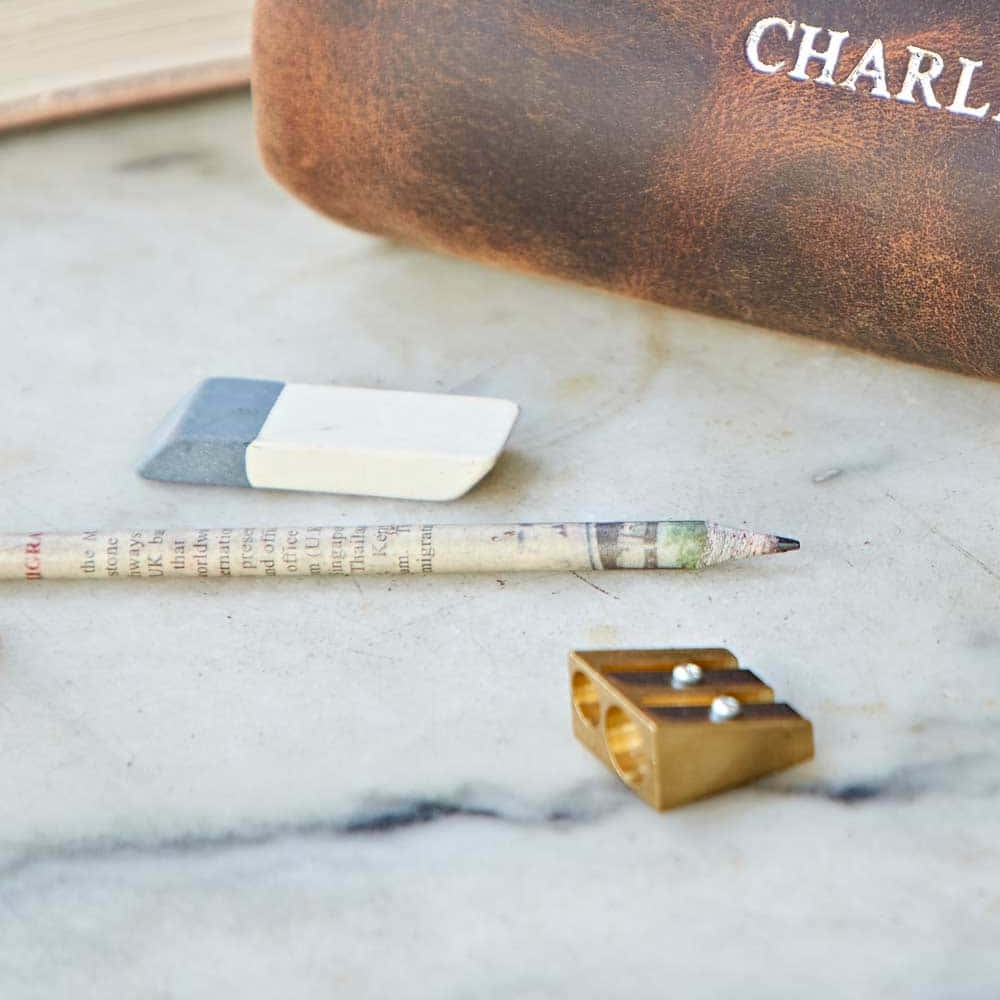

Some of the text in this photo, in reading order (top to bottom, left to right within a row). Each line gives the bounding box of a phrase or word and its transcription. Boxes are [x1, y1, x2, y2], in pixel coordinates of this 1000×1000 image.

[81, 549, 95, 574] the
[106, 536, 119, 577] stone
[282, 530, 298, 573] office
